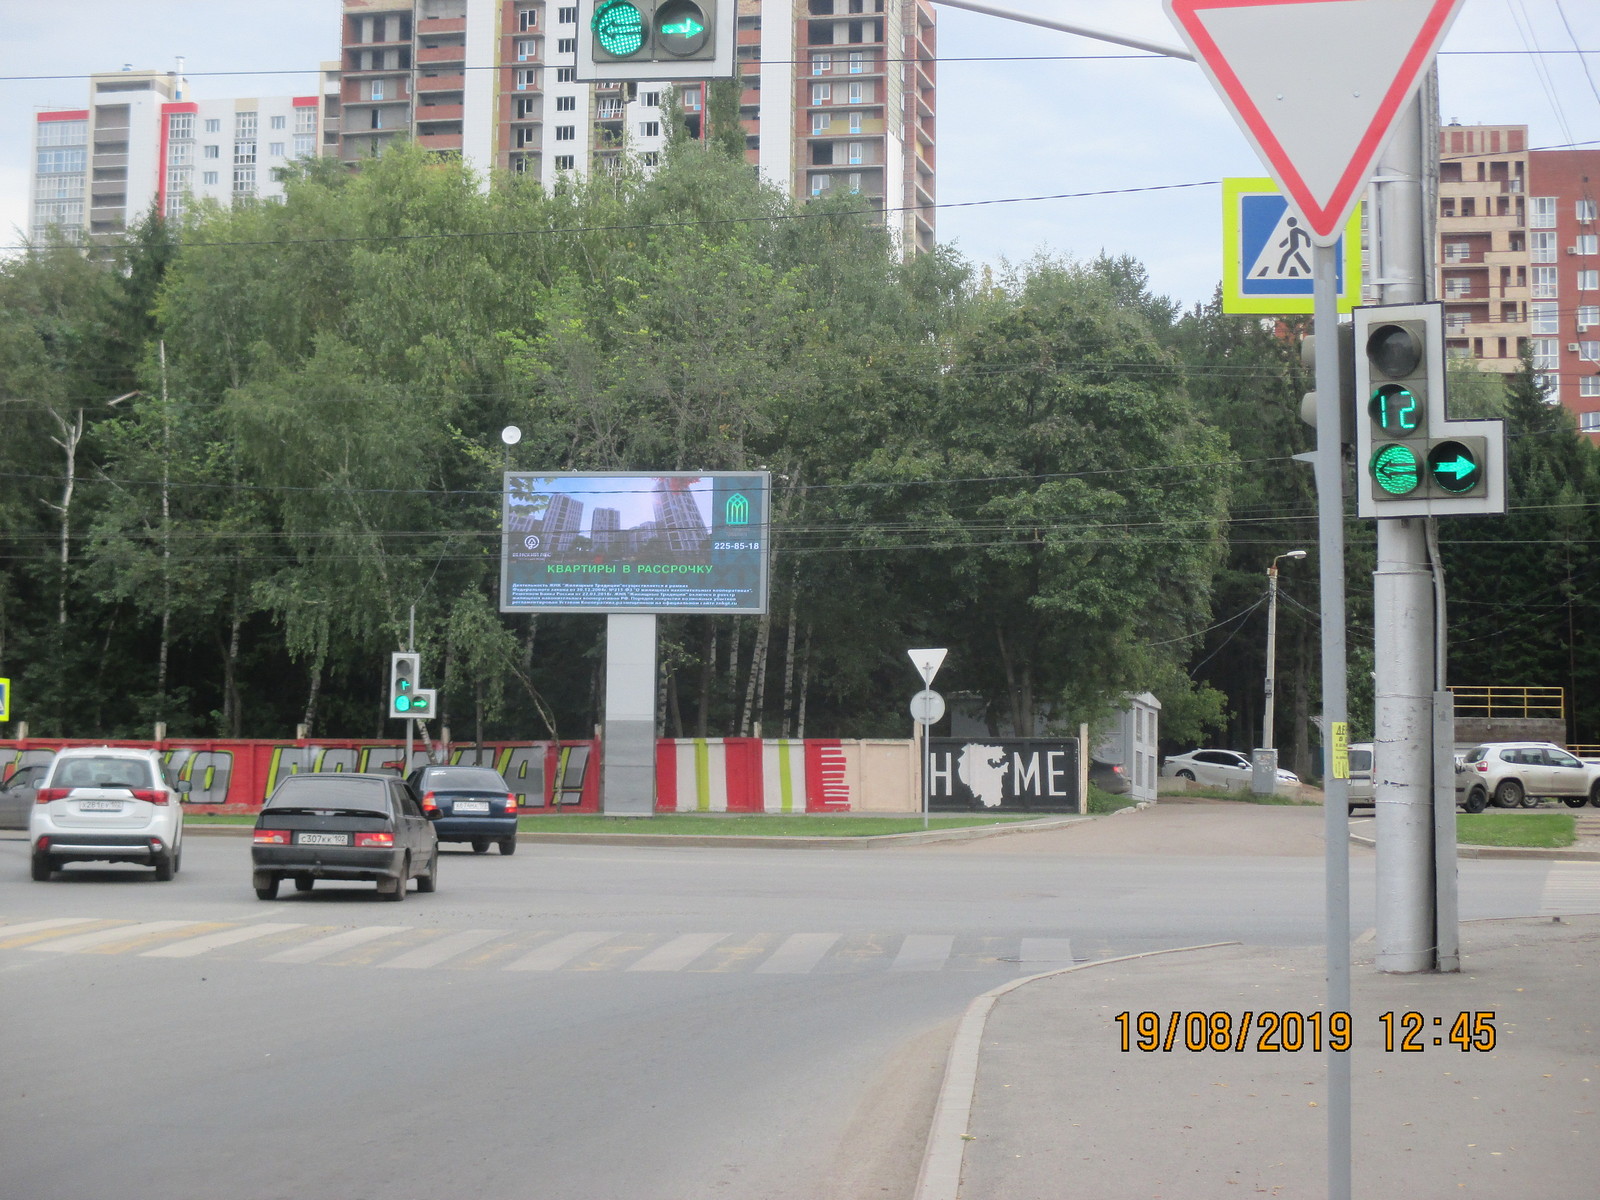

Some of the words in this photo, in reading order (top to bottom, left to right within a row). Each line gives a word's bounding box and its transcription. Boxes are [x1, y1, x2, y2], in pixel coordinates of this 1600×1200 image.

[1380, 390, 1417, 429] 12
[714, 542, 760, 550] 225-85-18
[547, 564, 616, 574] КВАРТИРЫ
[622, 564, 632, 574] В
[637, 564, 713, 574] РАССРОЧКУ
[930, 743, 1067, 808] HME
